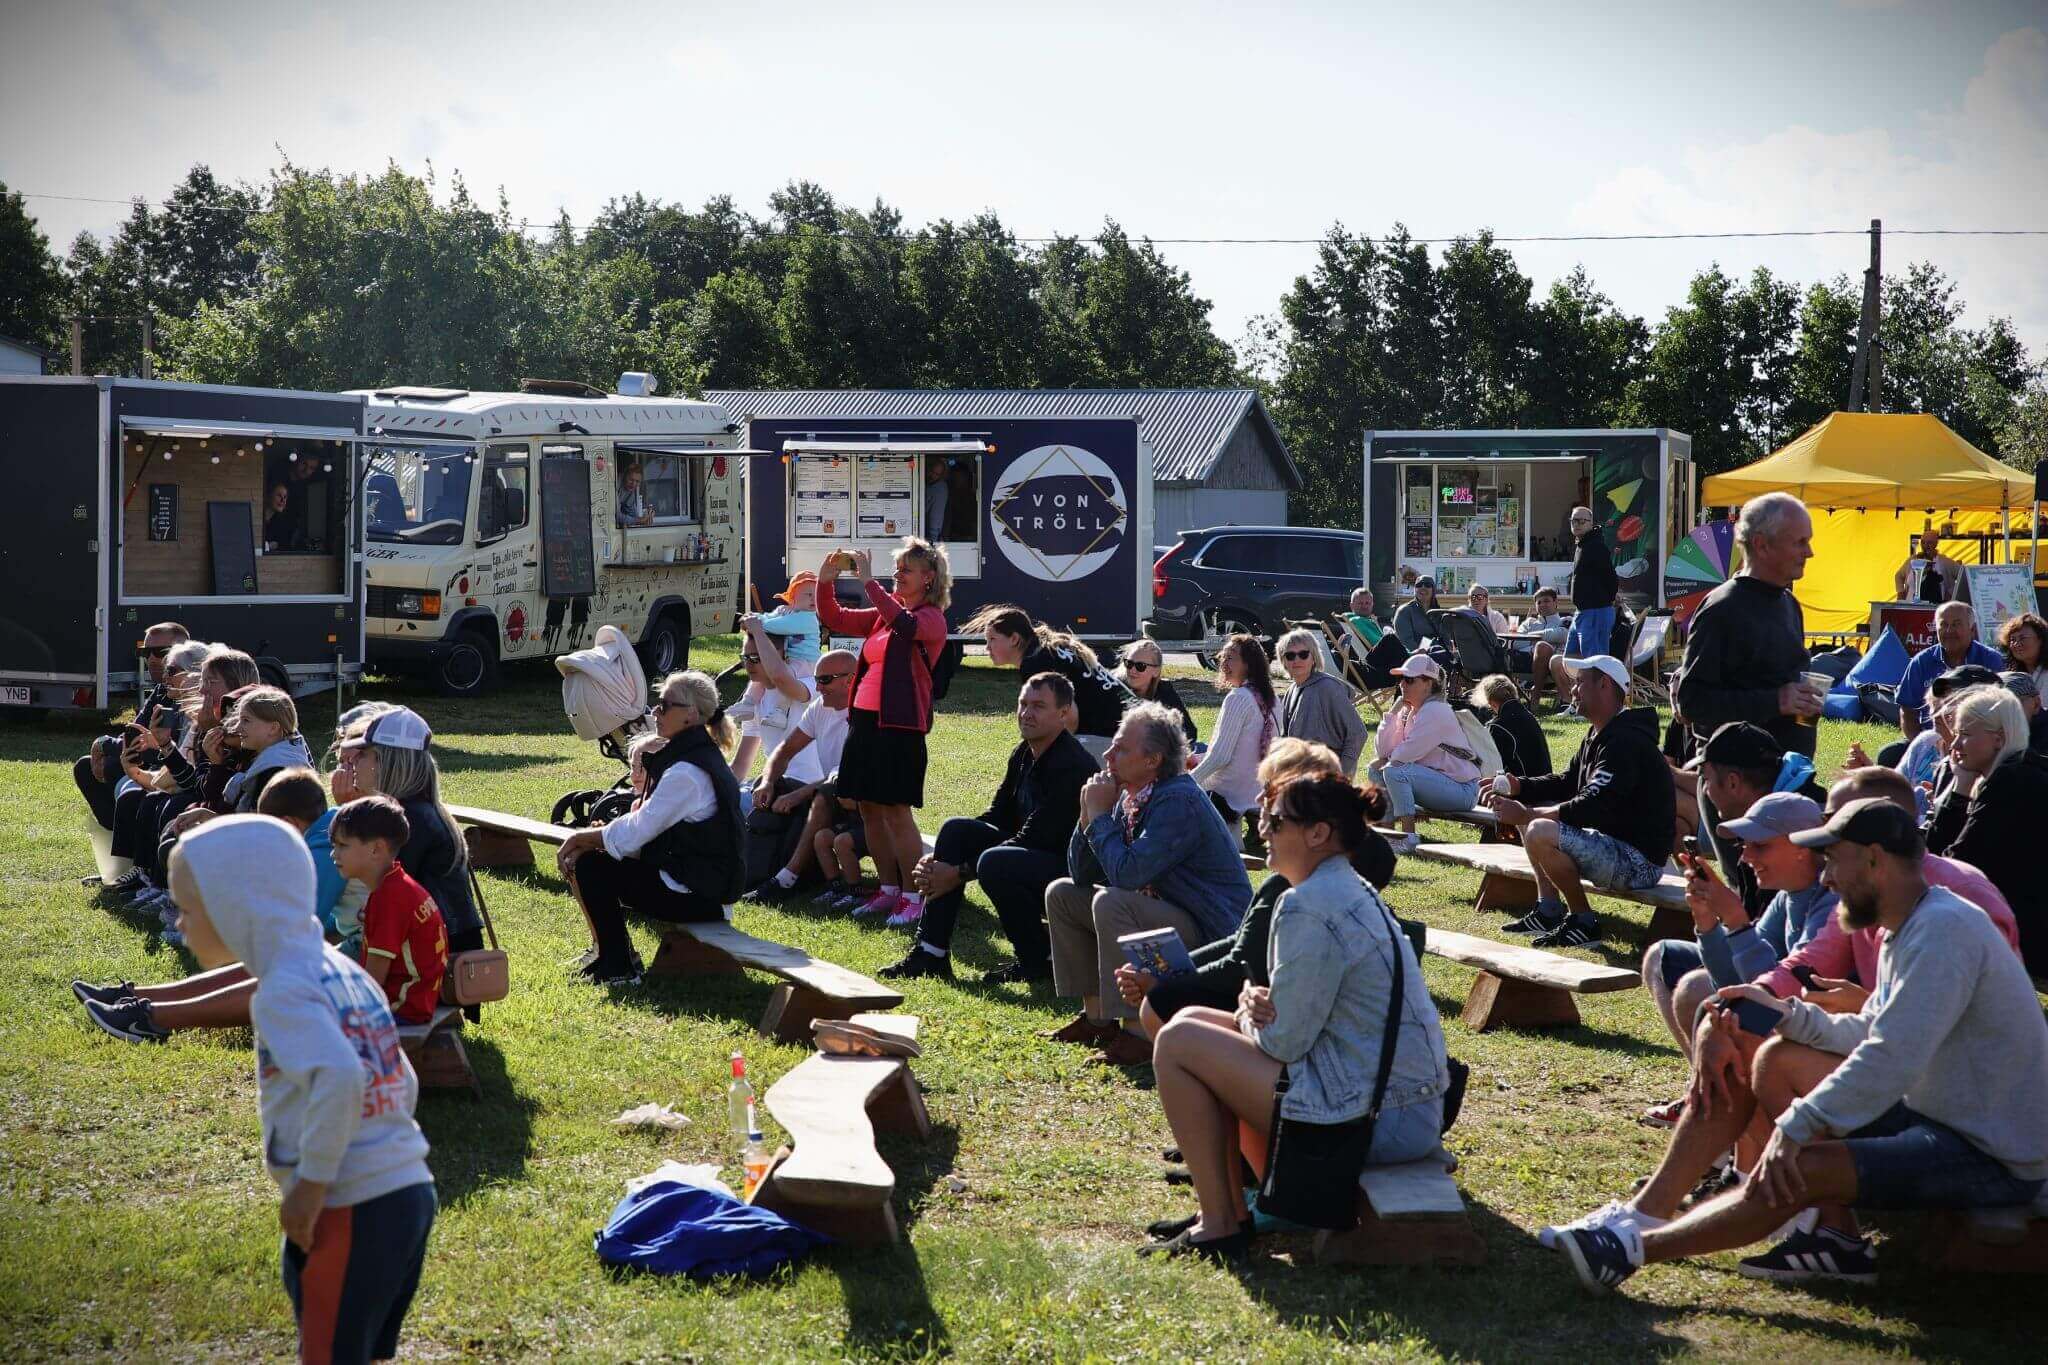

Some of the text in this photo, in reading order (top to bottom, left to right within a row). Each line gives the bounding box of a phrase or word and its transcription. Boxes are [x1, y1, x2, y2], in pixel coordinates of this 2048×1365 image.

[1032, 494, 1089, 508] VON
[1453, 495, 1474, 503] BAR
[1012, 513, 1105, 530] TRÖLL
[1700, 531, 1709, 541] 3
[1720, 526, 1728, 535] 4
[365, 548, 400, 560] GER
[1683, 543, 1692, 554] 2
[1905, 633, 1936, 647] A.Le
[5, 688, 28, 701] YNB
